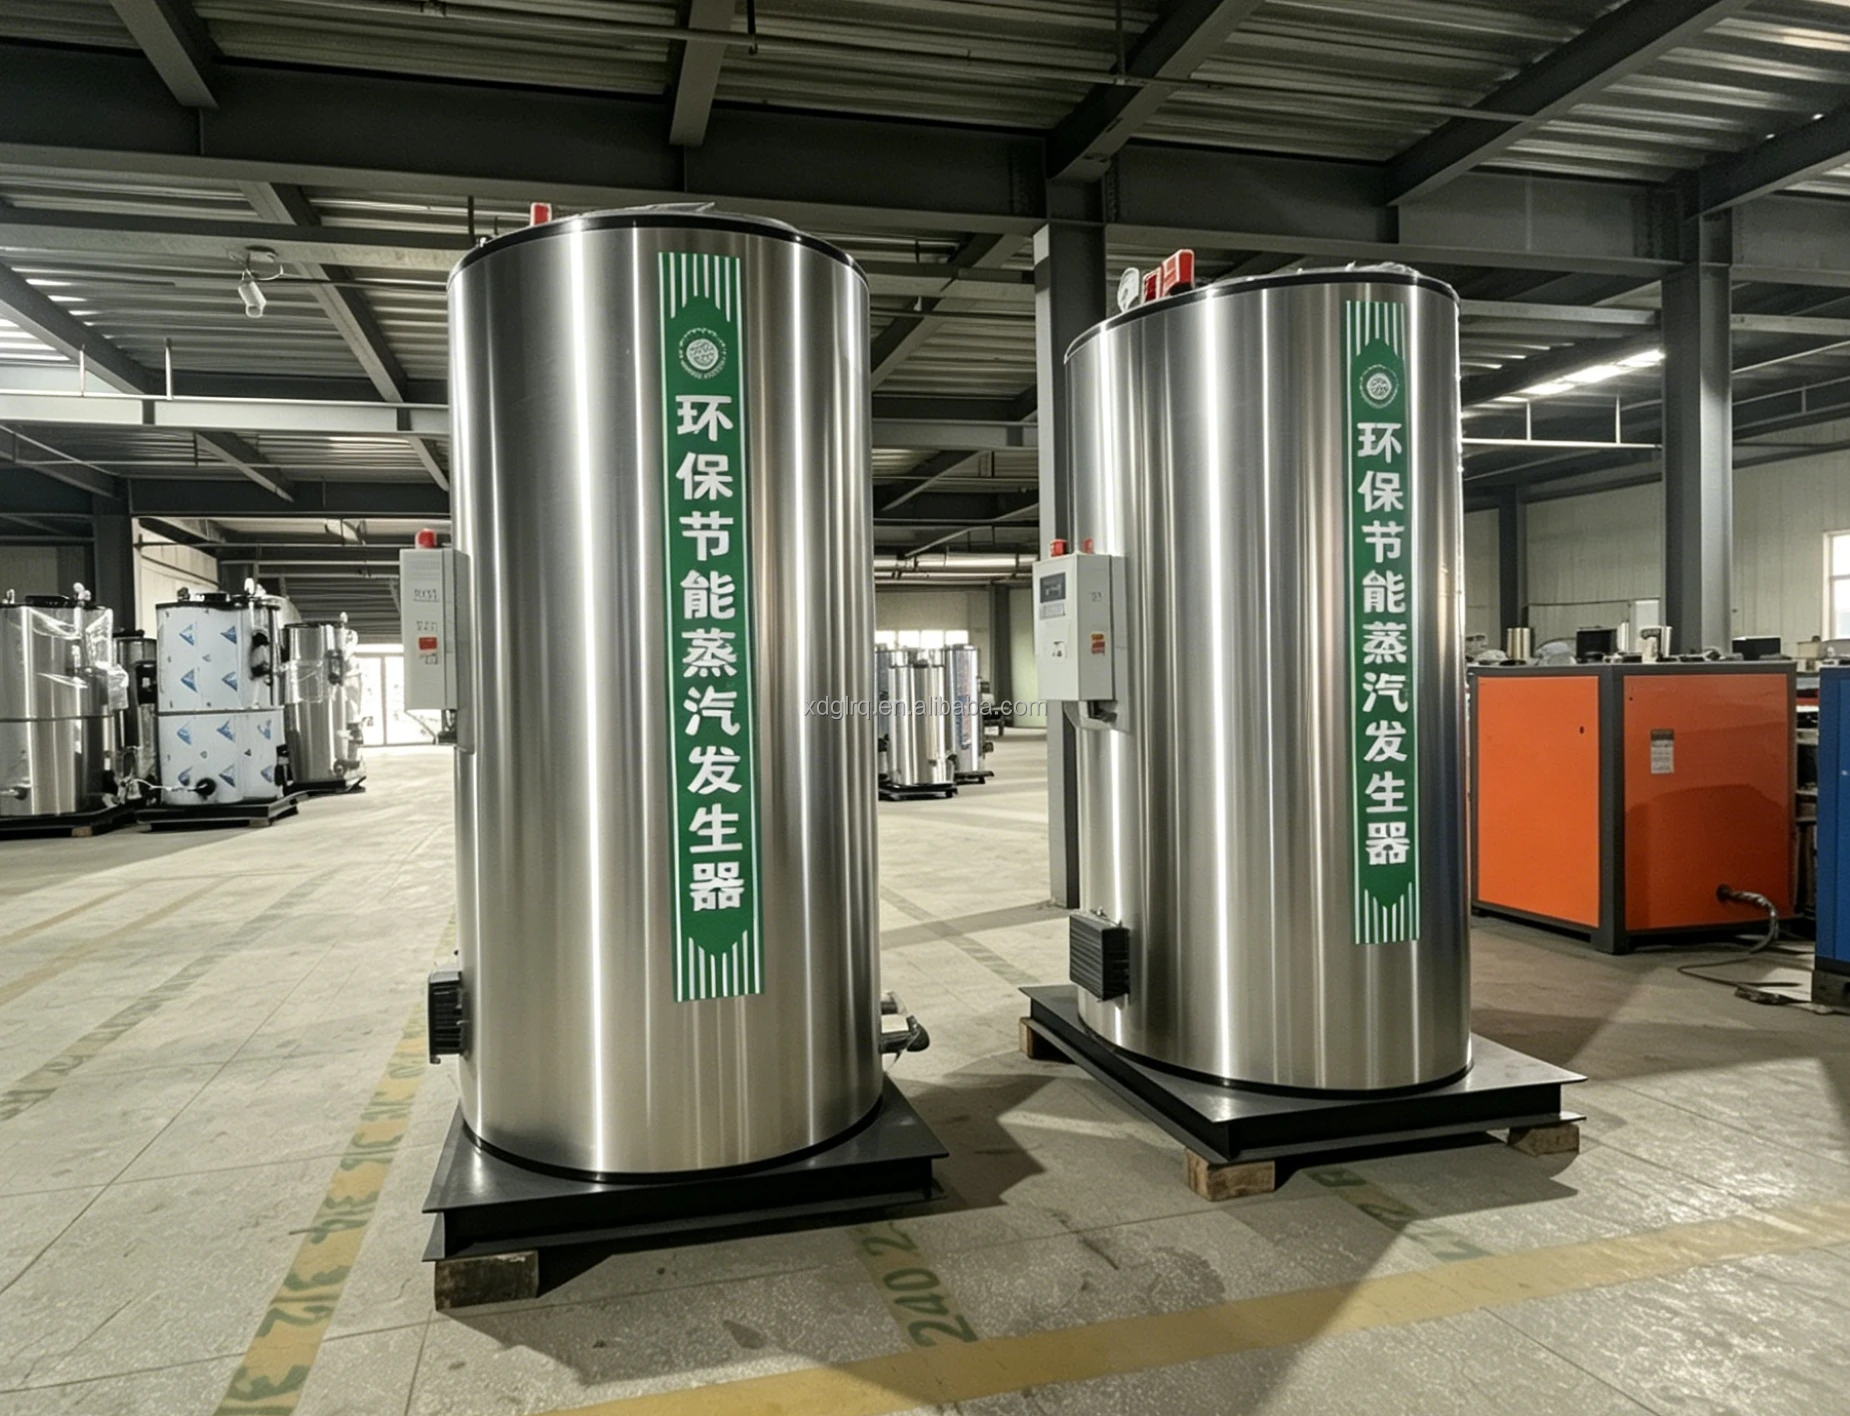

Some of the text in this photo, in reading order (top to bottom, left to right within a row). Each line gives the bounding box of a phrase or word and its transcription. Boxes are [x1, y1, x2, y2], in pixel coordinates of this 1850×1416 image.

[675, 394, 745, 912] 环保节能蒸汽发生器
[1356, 421, 1411, 866] 环保节能蒸汽发生器
